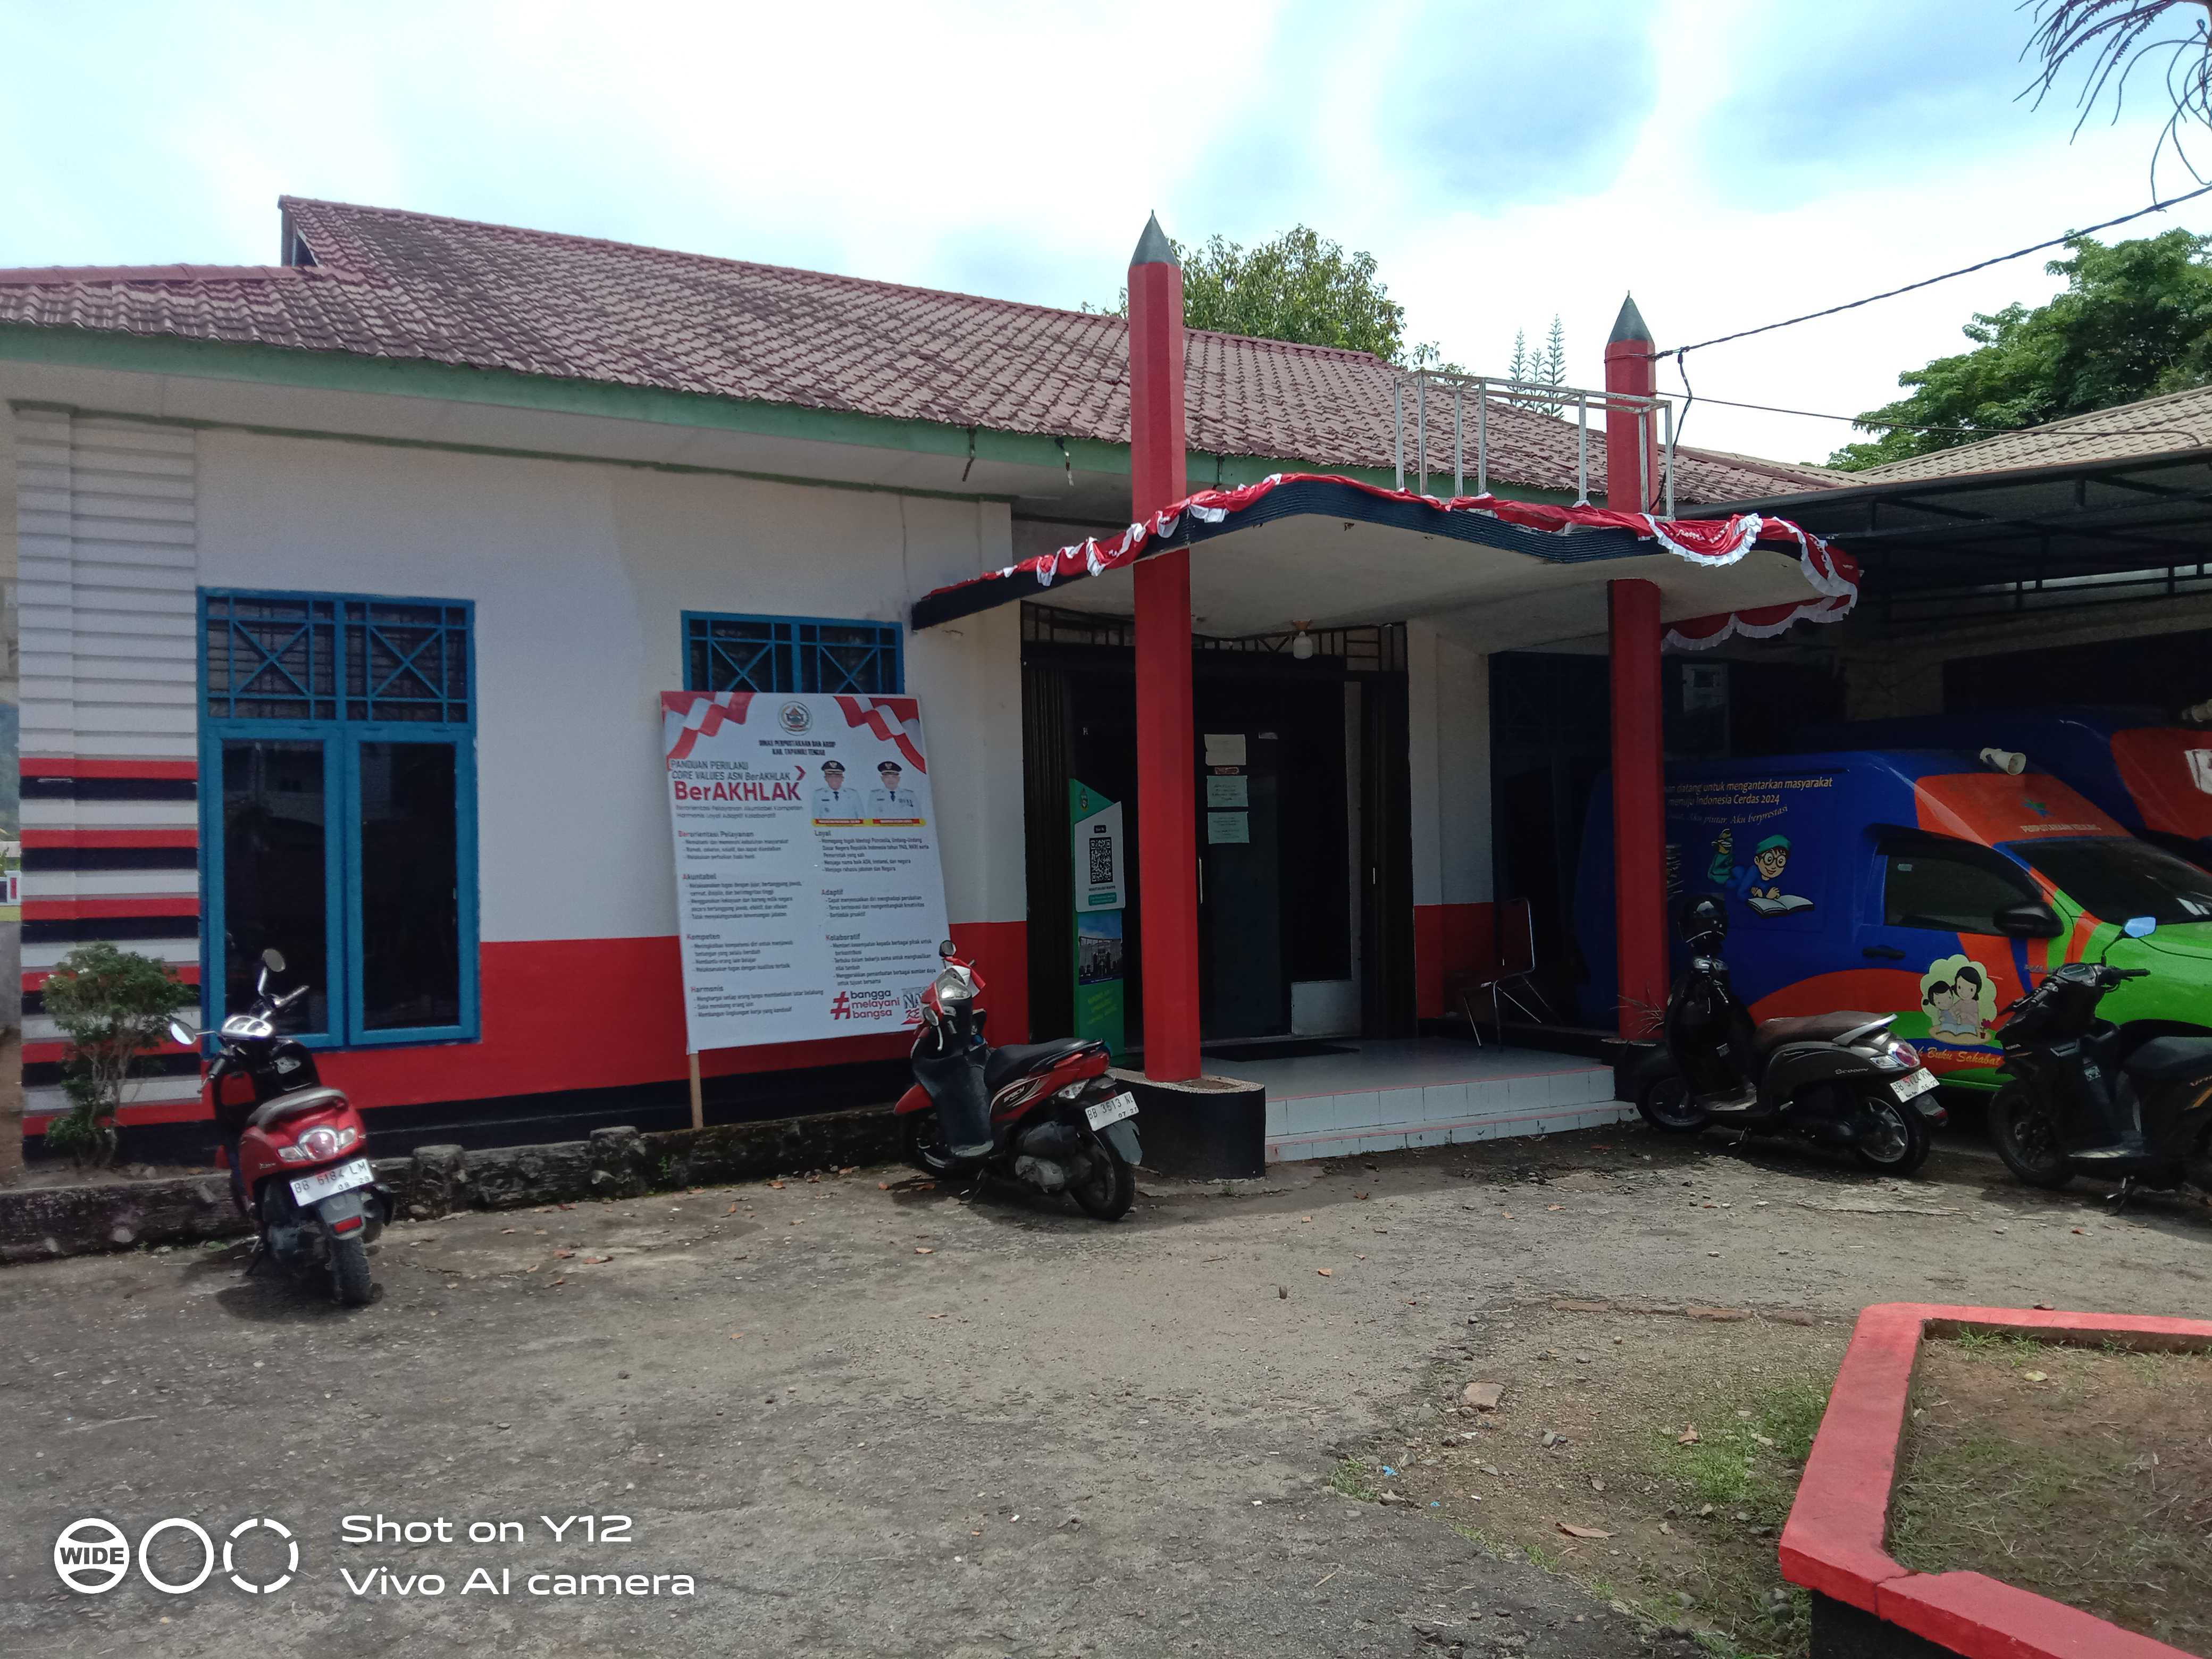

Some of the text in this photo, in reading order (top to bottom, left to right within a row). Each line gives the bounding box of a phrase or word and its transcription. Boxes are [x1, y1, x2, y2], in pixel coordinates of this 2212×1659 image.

[671, 759, 708, 769] PANDUAN
[672, 770, 693, 780] CORE
[696, 772, 725, 780] VALUES
[745, 772, 790, 781] BerAKHLAK
[674, 781, 802, 801] BerAKHLAK
[1703, 782, 1725, 792] untuk
[1727, 778, 1783, 793] mengantarkan
[1784, 777, 1833, 791] masyarakat
[1696, 794, 1731, 805] Indonesia
[1733, 794, 1759, 805] Cerdas
[1761, 794, 1780, 805] 2024
[850, 990, 891, 1000] bangga
[851, 997, 900, 1009] melayani
[852, 1009, 892, 1019] bangsa
[1927, 1047, 1953, 1060] Buku
[1956, 1051, 2001, 1065] Sahabat
[1087, 1094, 1133, 1119] BB 3513 NL
[294, 1180, 309, 1193] BB
[348, 1161, 367, 1175] LM
